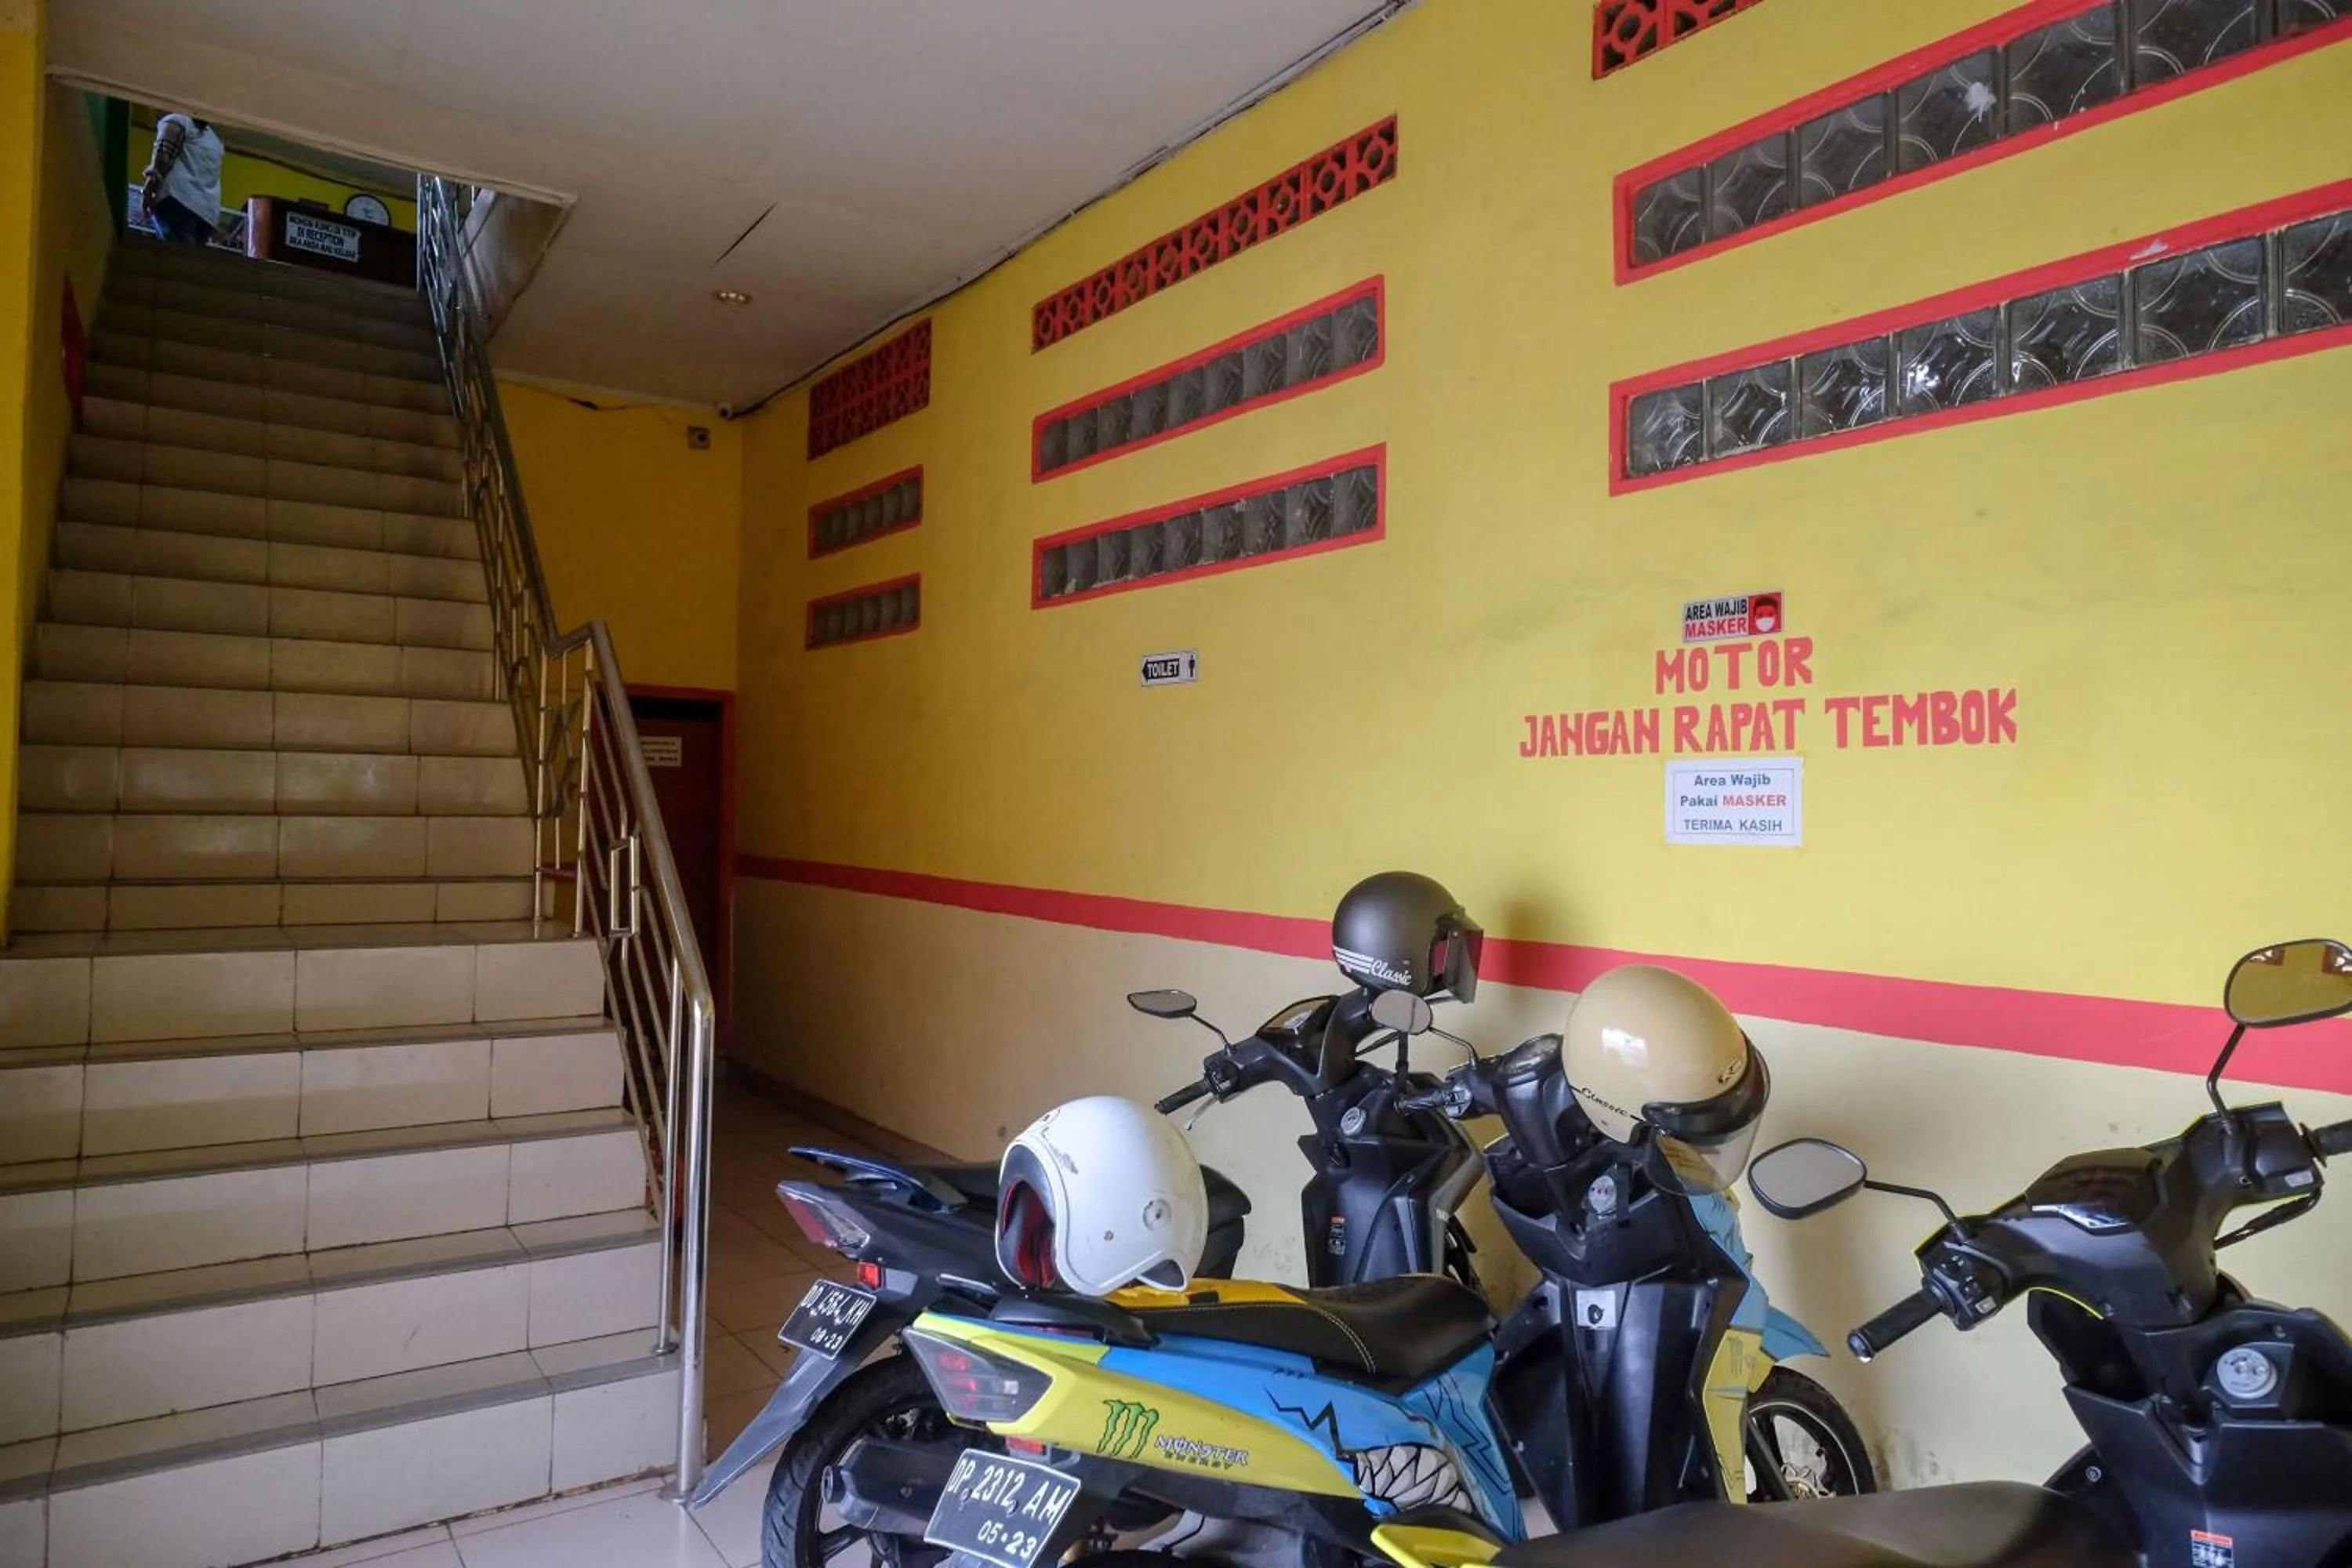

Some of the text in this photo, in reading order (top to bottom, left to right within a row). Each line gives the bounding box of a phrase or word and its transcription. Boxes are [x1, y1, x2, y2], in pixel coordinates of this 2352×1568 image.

[306, 227, 344, 247] RECEPTION
[1685, 598, 1748, 622] AREA WAJIB
[1685, 616, 1748, 639] MASKER
[1147, 661, 1179, 678] TOILET
[1655, 637, 1813, 695] MOTOR
[1519, 688, 2017, 758] JANGAN RAPAT TEMBOK
[1693, 773, 1771, 788] Area Wajib
[1680, 793, 1787, 807] Pakai MASKER
[1684, 818, 1783, 832] TERIMA KASIH
[1370, 958, 1412, 985] Classic
[1154, 1434, 1249, 1467] MONSTER
[946, 1457, 1072, 1526] DP 2312 AM
